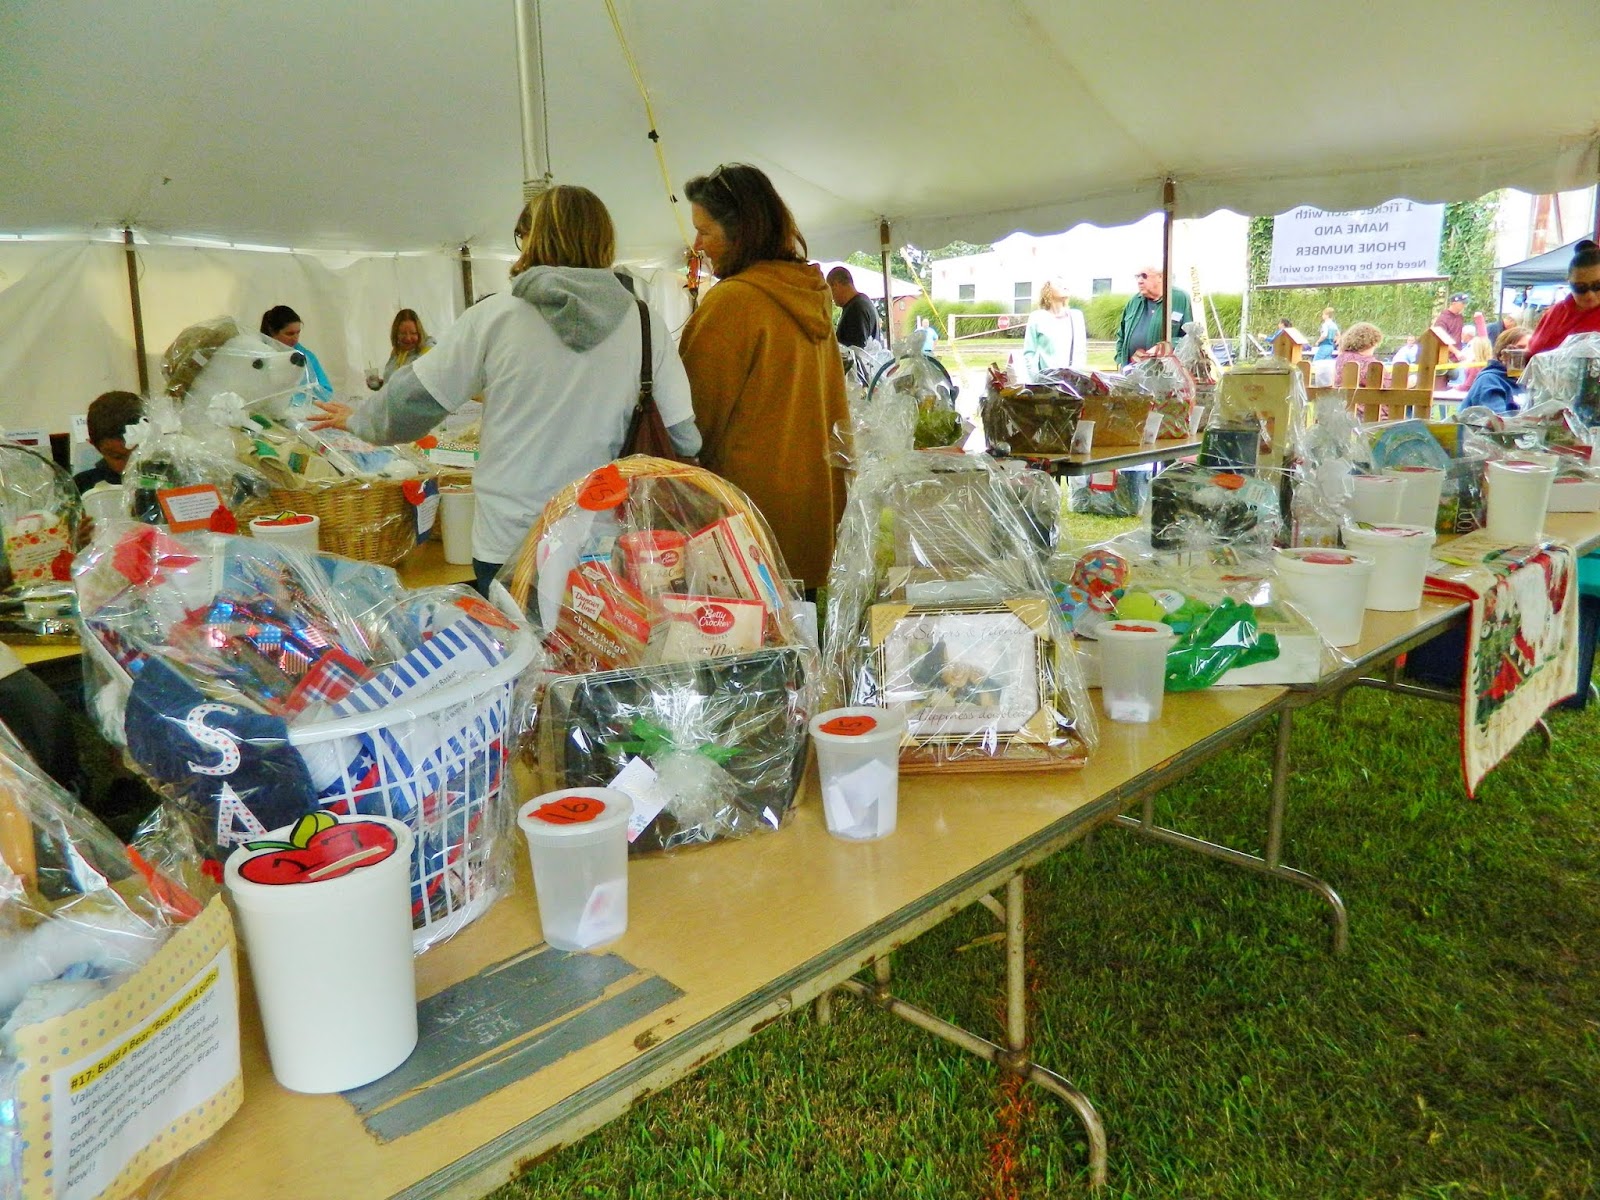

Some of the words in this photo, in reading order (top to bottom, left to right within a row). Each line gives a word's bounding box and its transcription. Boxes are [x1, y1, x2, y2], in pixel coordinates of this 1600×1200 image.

[574, 590, 600, 609] Duncan
[577, 602, 597, 616] Hines
[699, 616, 730, 628] Crocker
[705, 608, 727, 621] Betty
[573, 615, 600, 639] chewy
[600, 633, 628, 655] fudge
[578, 627, 617, 659] brownies
[544, 802, 590, 821] 16
[70, 1069, 96, 1090] #17:
[98, 1050, 121, 1074] Build
[121, 1046, 128, 1056] a
[177, 994, 193, 1012] with
[70, 1106, 91, 1125] and
